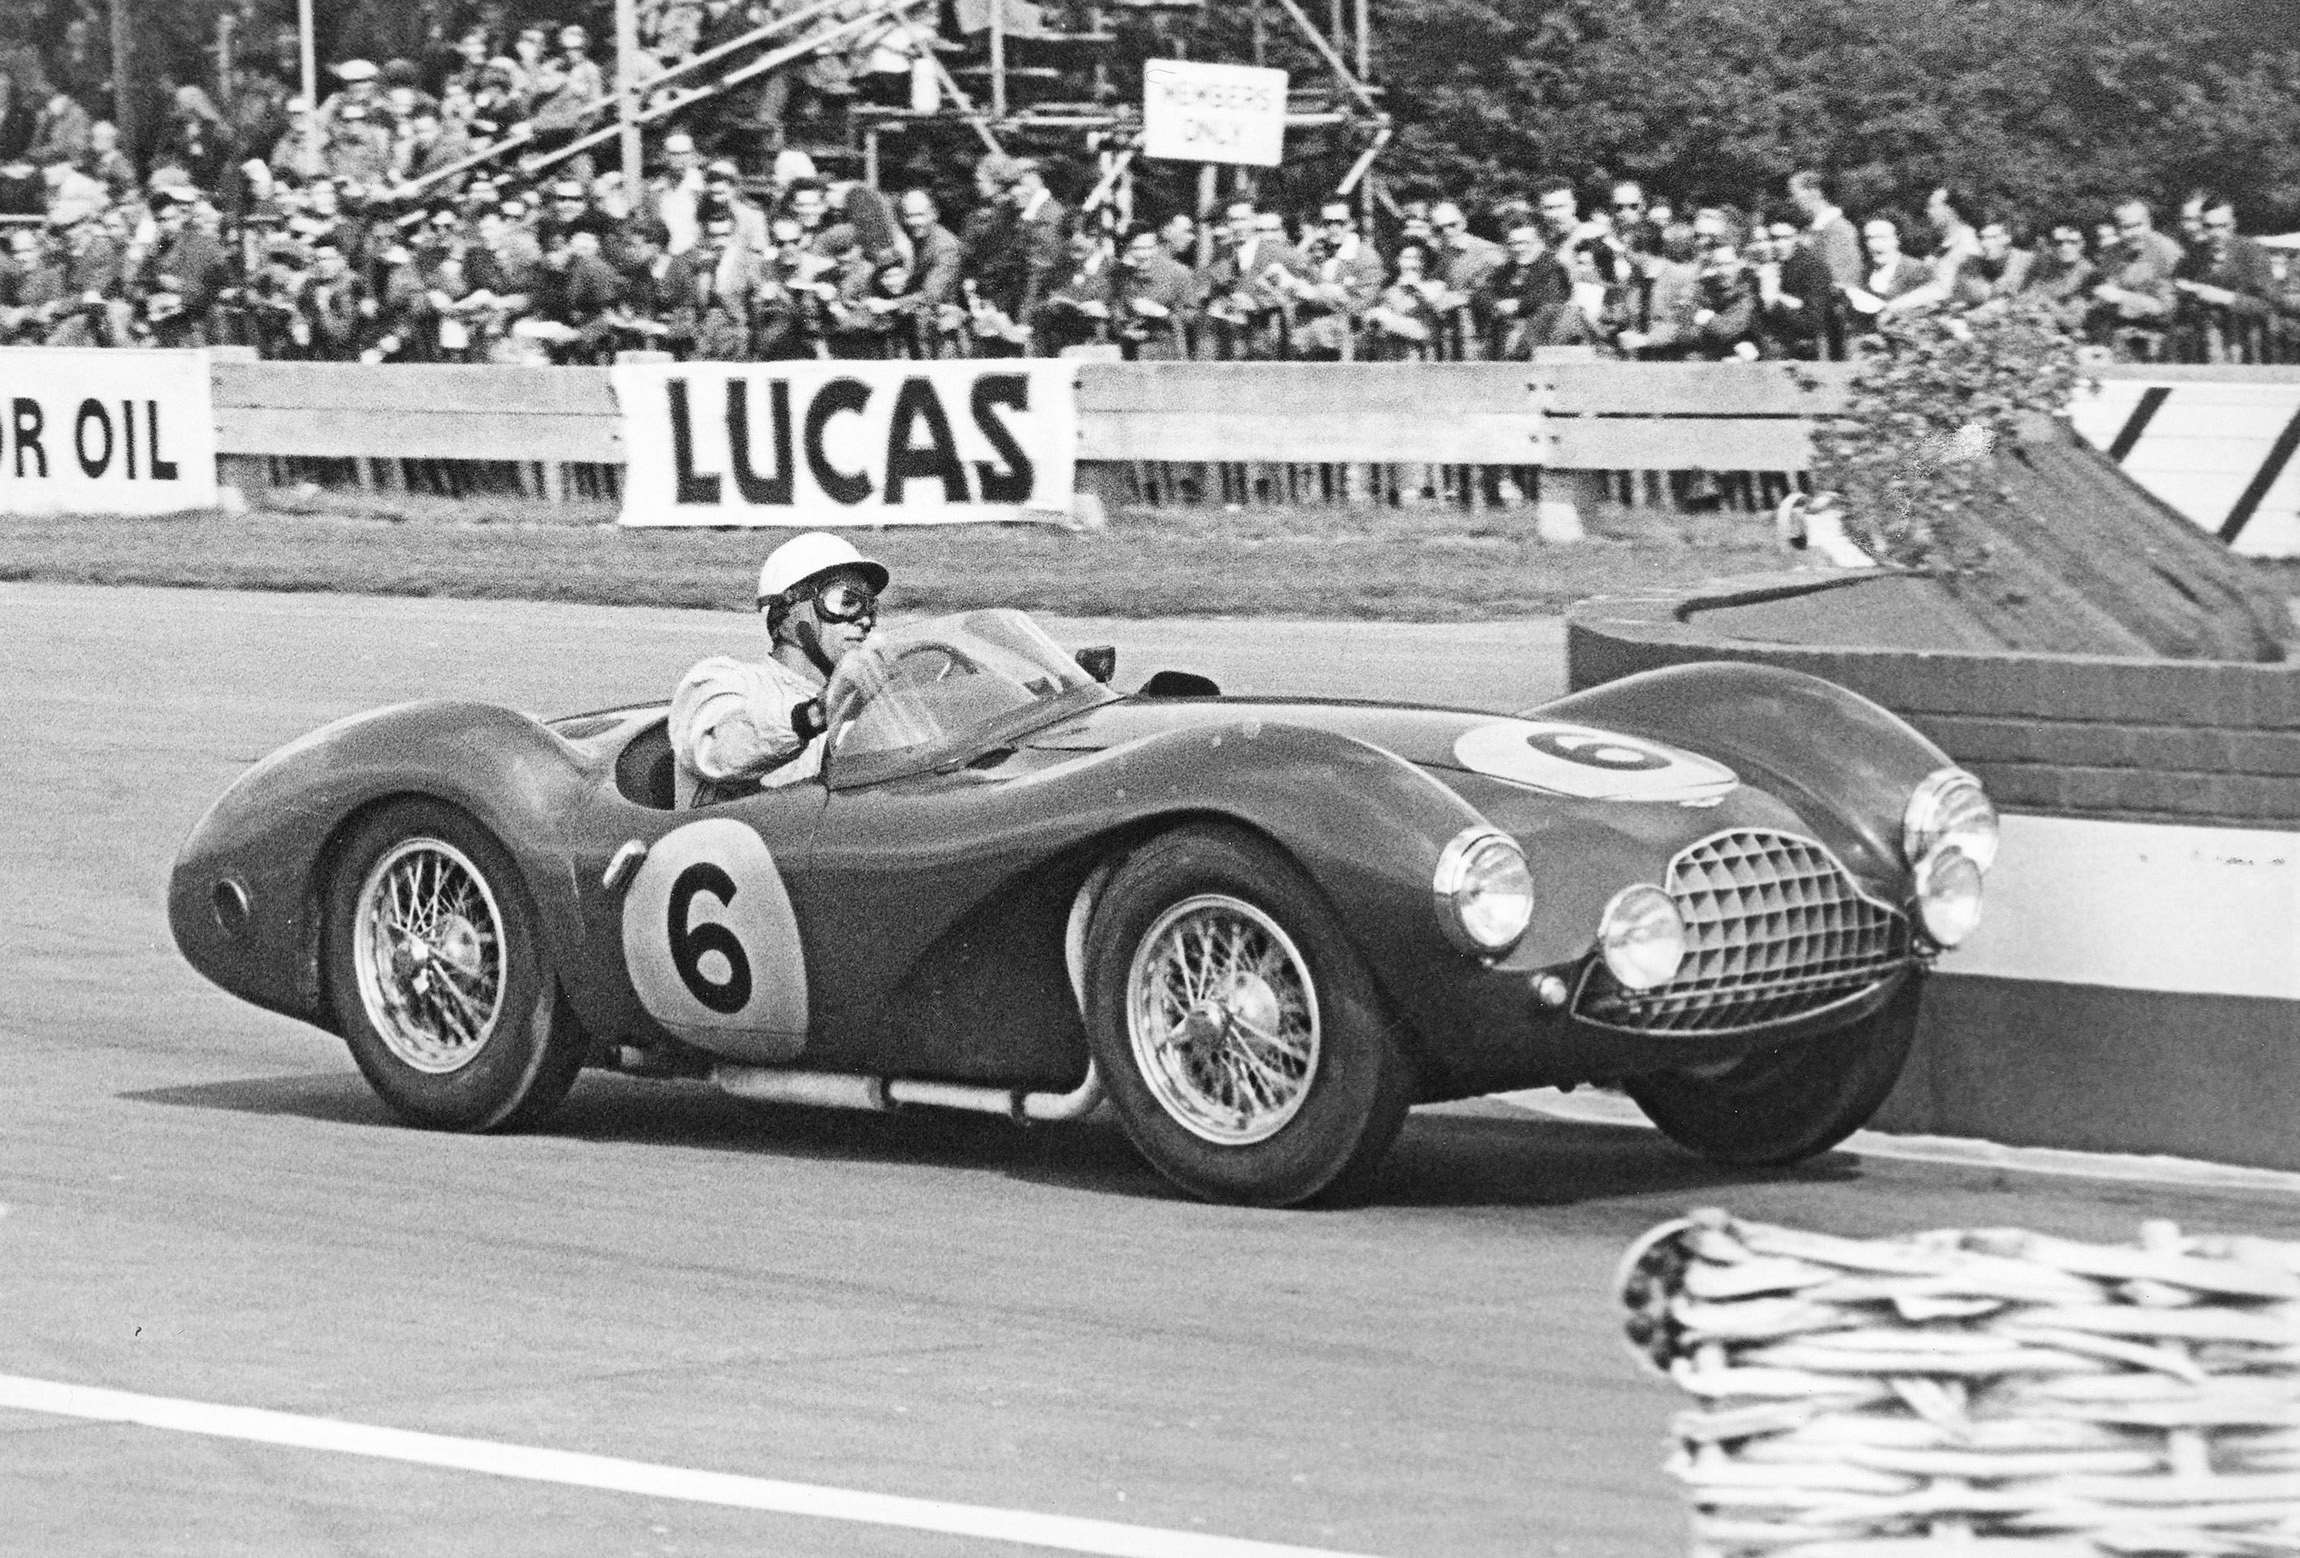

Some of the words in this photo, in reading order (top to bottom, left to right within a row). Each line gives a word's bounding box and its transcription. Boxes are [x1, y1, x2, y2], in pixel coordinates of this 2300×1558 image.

[0, 397, 49, 479] R
[75, 397, 179, 480] OIL
[666, 372, 1034, 505] LUCAS
[1525, 731, 1672, 771] 6
[667, 861, 753, 1015] 6
